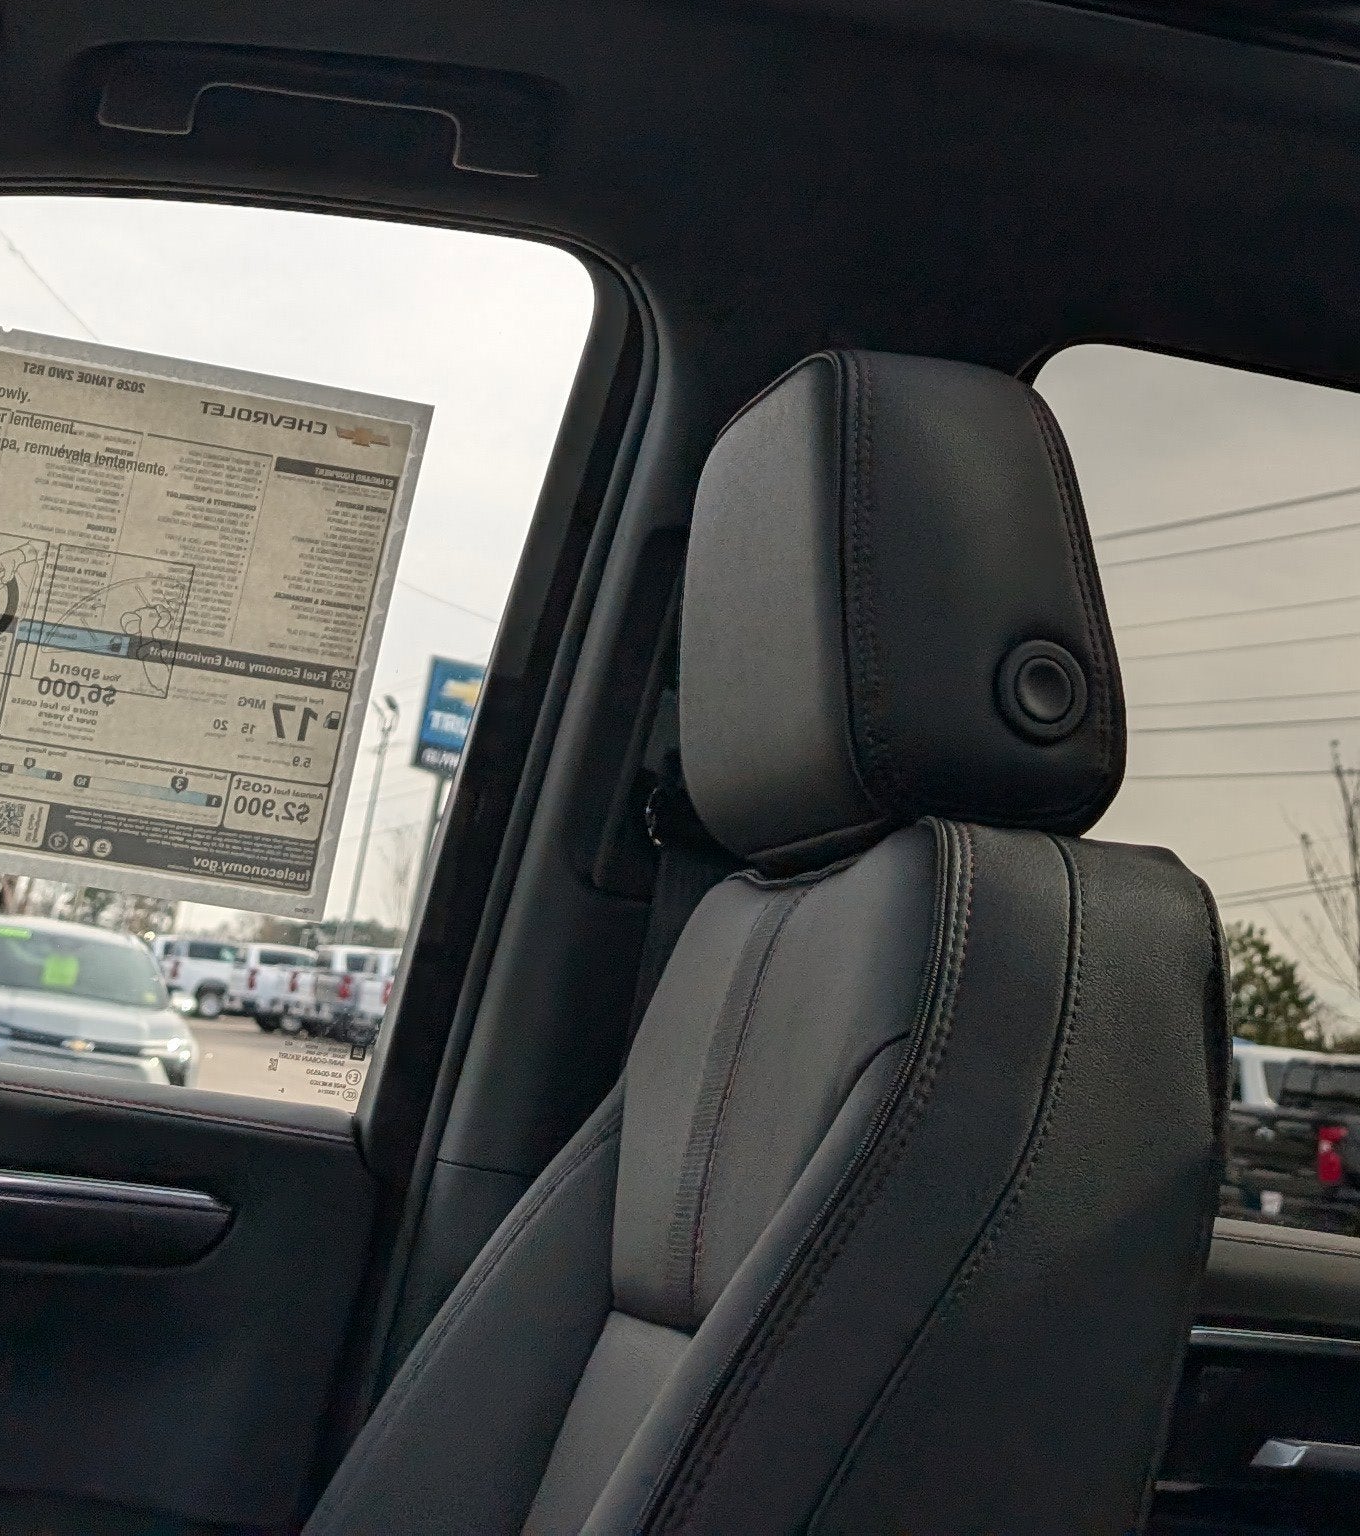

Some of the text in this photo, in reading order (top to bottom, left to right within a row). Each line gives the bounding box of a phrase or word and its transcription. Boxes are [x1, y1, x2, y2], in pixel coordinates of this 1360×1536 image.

[8, 411, 78, 435] lentement.
[23, 439, 91, 463] remuévala
[93, 452, 169, 477] lentamente.
